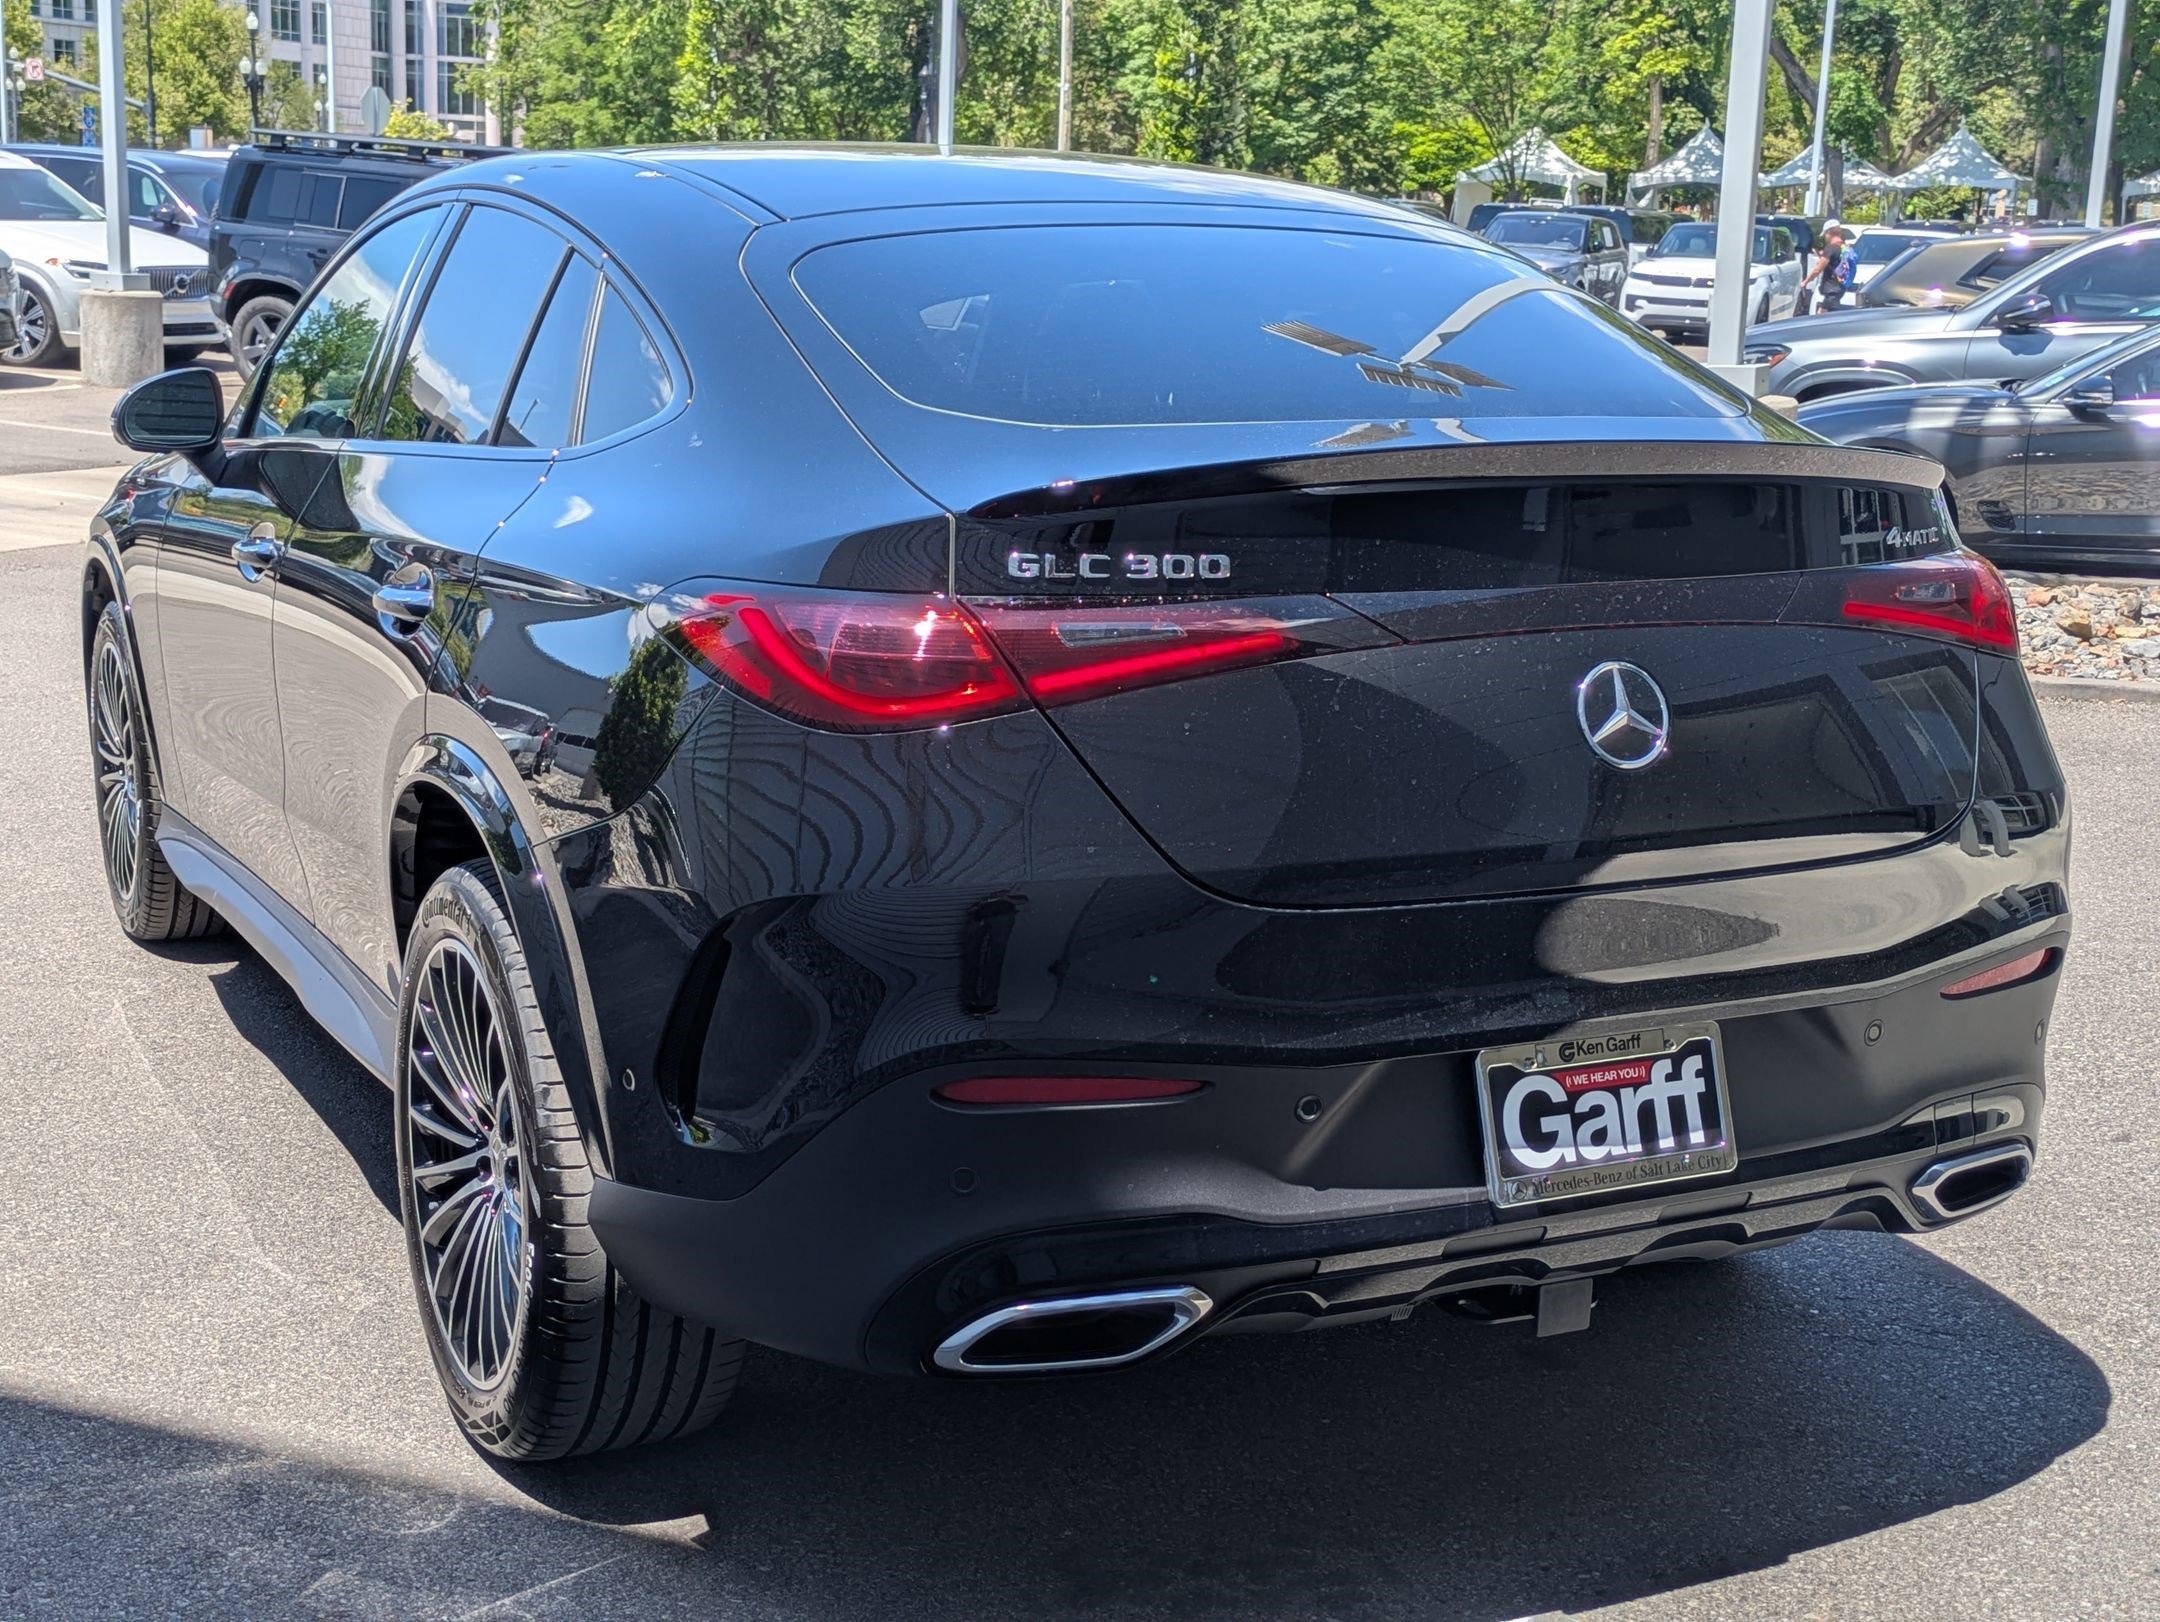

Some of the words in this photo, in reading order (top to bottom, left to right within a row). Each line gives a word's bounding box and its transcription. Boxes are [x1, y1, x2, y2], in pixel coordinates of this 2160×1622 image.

[1886, 526, 1940, 548] 4MATIC
[1008, 552, 1111, 578] GLC
[1126, 553, 1231, 579] 300
[1576, 1040, 1604, 1056] Ken
[1606, 1034, 1641, 1052] Garff
[1572, 1074, 1589, 1085] WE
[1590, 1070, 1618, 1083] HEAR
[1618, 1067, 1639, 1079] YOU
[1503, 1054, 1705, 1168] Garff
[1532, 1170, 1623, 1195] Mercedes-Benz
[1626, 1166, 1637, 1180] of
[1640, 1161, 1663, 1178] Salt
[1666, 1156, 1694, 1173] Lake
[1698, 1155, 1723, 1171] City
